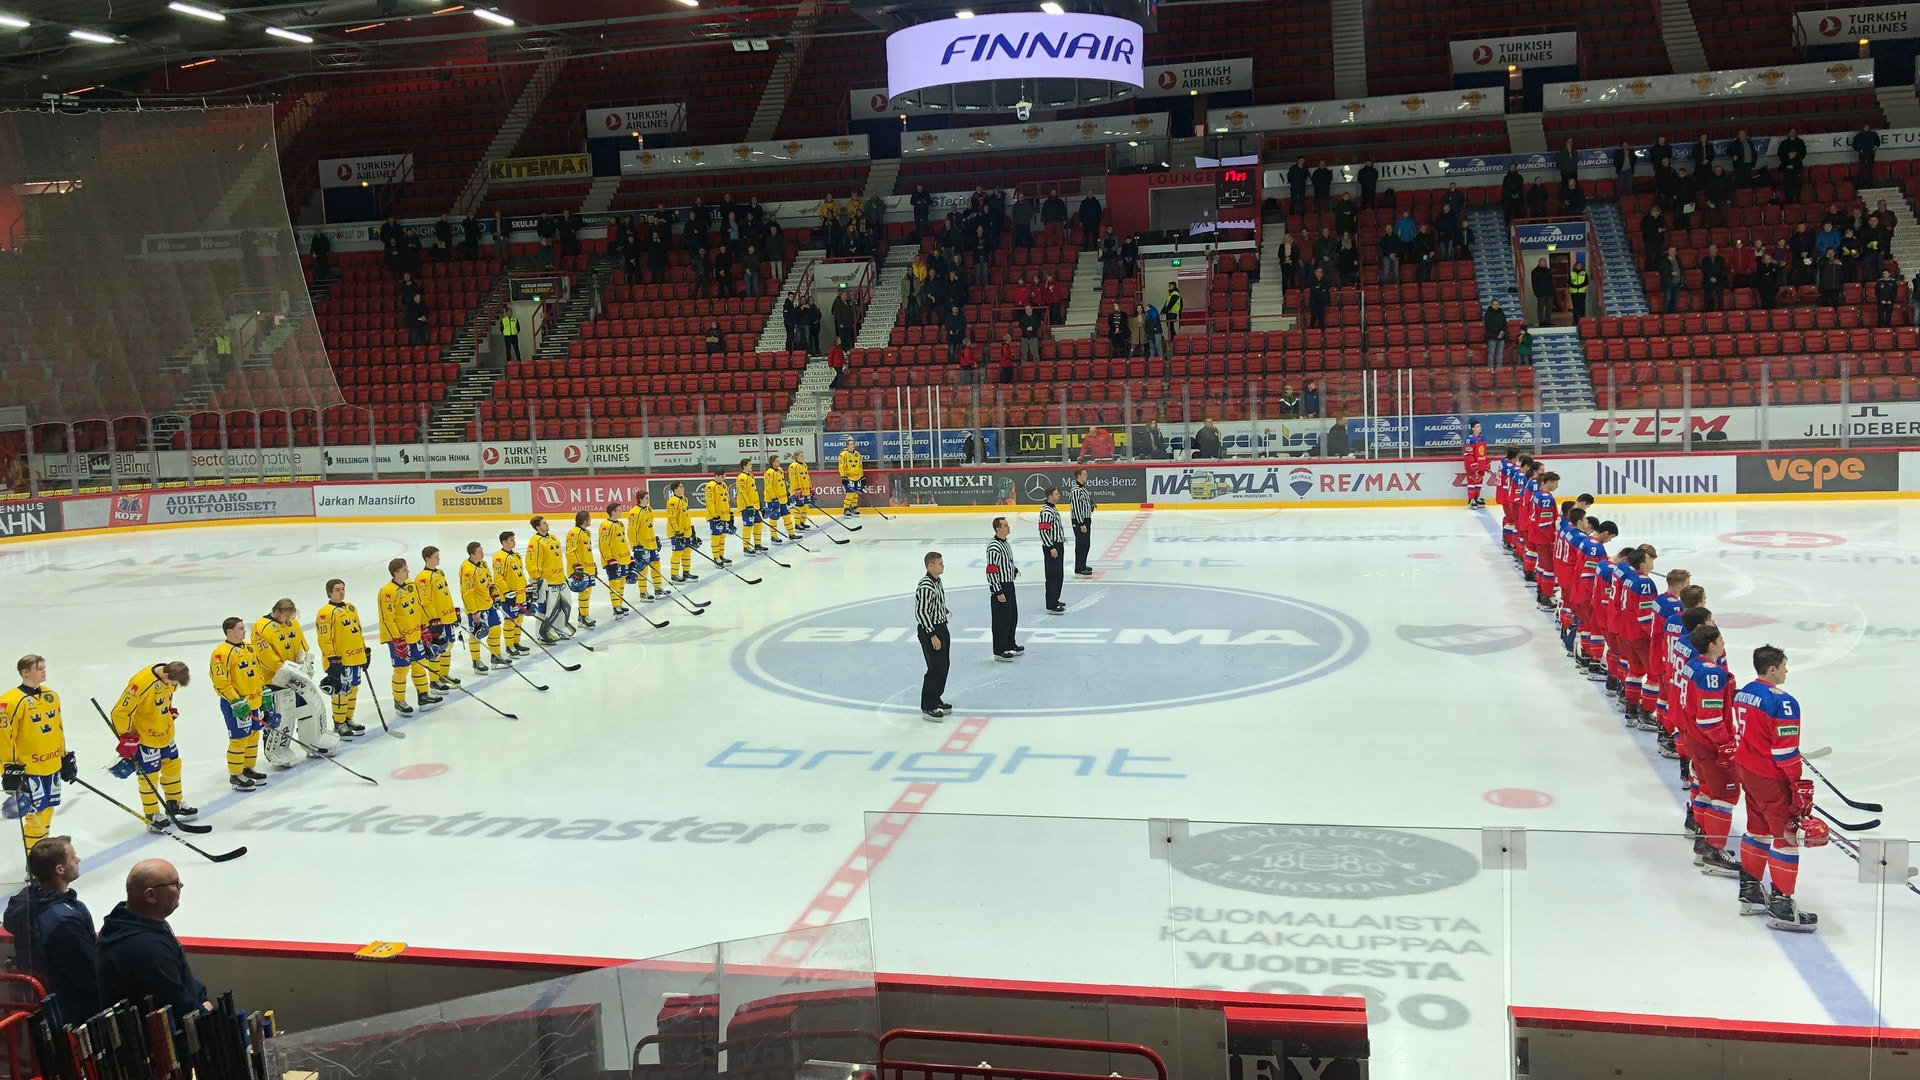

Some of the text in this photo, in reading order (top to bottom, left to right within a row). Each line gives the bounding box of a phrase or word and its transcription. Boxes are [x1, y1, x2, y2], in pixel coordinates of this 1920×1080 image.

[1849, 11, 1907, 24] TURKISH
[1848, 22, 1907, 35] AIRLINES
[941, 32, 1134, 66] FINNAIR
[1499, 40, 1552, 53] TURKISH
[1499, 51, 1552, 64] AIRLINES
[1182, 65, 1231, 79] TURKISH
[1182, 74, 1232, 89] AIRLINES
[626, 110, 667, 121] TURKISH
[626, 120, 668, 130] AIRLINES
[356, 161, 395, 171] TURKISH
[357, 170, 396, 180] AIRLINES
[1149, 172, 1214, 185] LOUNGE
[1519, 233, 1584, 243] KAUKOKIITO
[1587, 415, 1731, 437] CCM
[336, 456, 369, 464] HELSINGIN
[1766, 457, 1865, 489] vepe
[909, 475, 993, 488] HORMEX.FI
[1319, 472, 1422, 492] RE/MAX
[1658, 474, 1718, 493] NIINI
[166, 492, 247, 505] AUKEAAKO
[319, 494, 415, 507] Jarkan Maansiirto
[442, 497, 503, 506] REISSUMIES
[1542, 499, 1551, 507] 22
[166, 501, 277, 515] VOITTOBISSET?
[114, 510, 143, 521] KOFF
[1590, 547, 1597, 556] 3
[1641, 583, 1651, 594] 21
[387, 604, 393, 612] 4
[319, 624, 328, 635] 10
[257, 640, 269, 651] 30
[216, 664, 225, 676] 21
[1706, 674, 1719, 688] 18
[121, 697, 131, 707] 6
[1783, 701, 1793, 716] 5
[706, 740, 1188, 783] bright
[1222, 825, 1422, 848] KALATUKKU
[1405, 868, 1449, 887] OY
[1166, 905, 1481, 934] SUOMALAISTA
[1158, 925, 1491, 956] KALAKAUPPAA
[1185, 950, 1464, 982] VUODESTA
